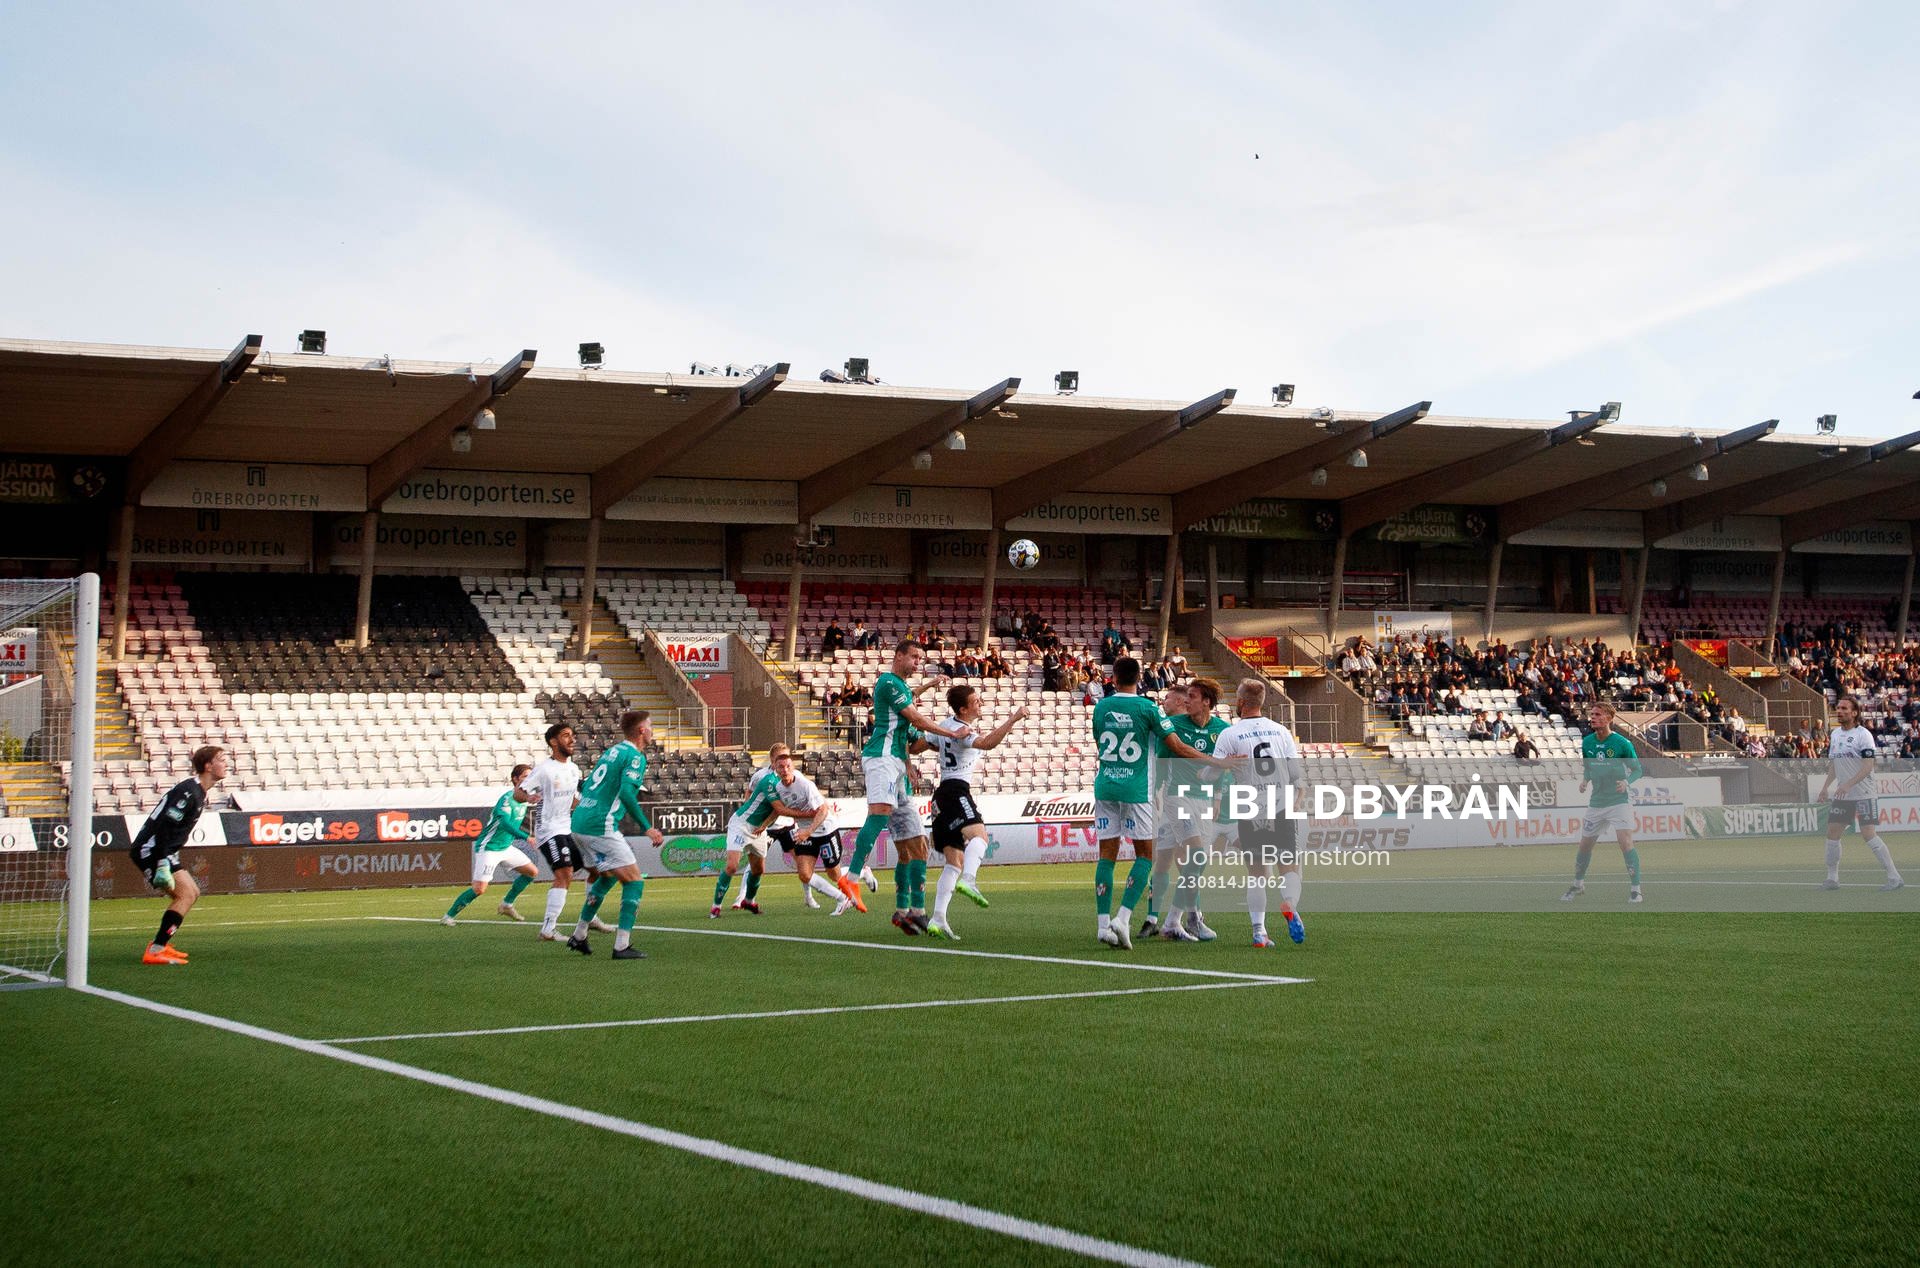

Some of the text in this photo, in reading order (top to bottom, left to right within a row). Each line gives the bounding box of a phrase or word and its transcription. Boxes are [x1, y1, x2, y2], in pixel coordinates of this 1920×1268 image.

[192, 489, 320, 507] ÖREBROPORTEN
[1219, 503, 1287, 518] AMMANS
[853, 510, 954, 527] ÖREBROPORTEN
[340, 524, 518, 549] orbroporten.se
[762, 550, 889, 568] ÖREOPORTEN
[667, 644, 720, 662] MAXI
[944, 741, 958, 767] 5
[1100, 731, 1142, 763] 26
[1253, 742, 1276, 777] 6
[589, 763, 608, 791] 9
[253, 817, 360, 844] laget.se
[378, 815, 483, 842] laget.se
[659, 814, 717, 830] TYBBLE
[1487, 813, 1582, 839] VI HJÄLP
[1723, 807, 1819, 836] SUPERETTAN
[1305, 828, 1412, 851] SPORTS
[319, 854, 443, 876] FORMMAX
